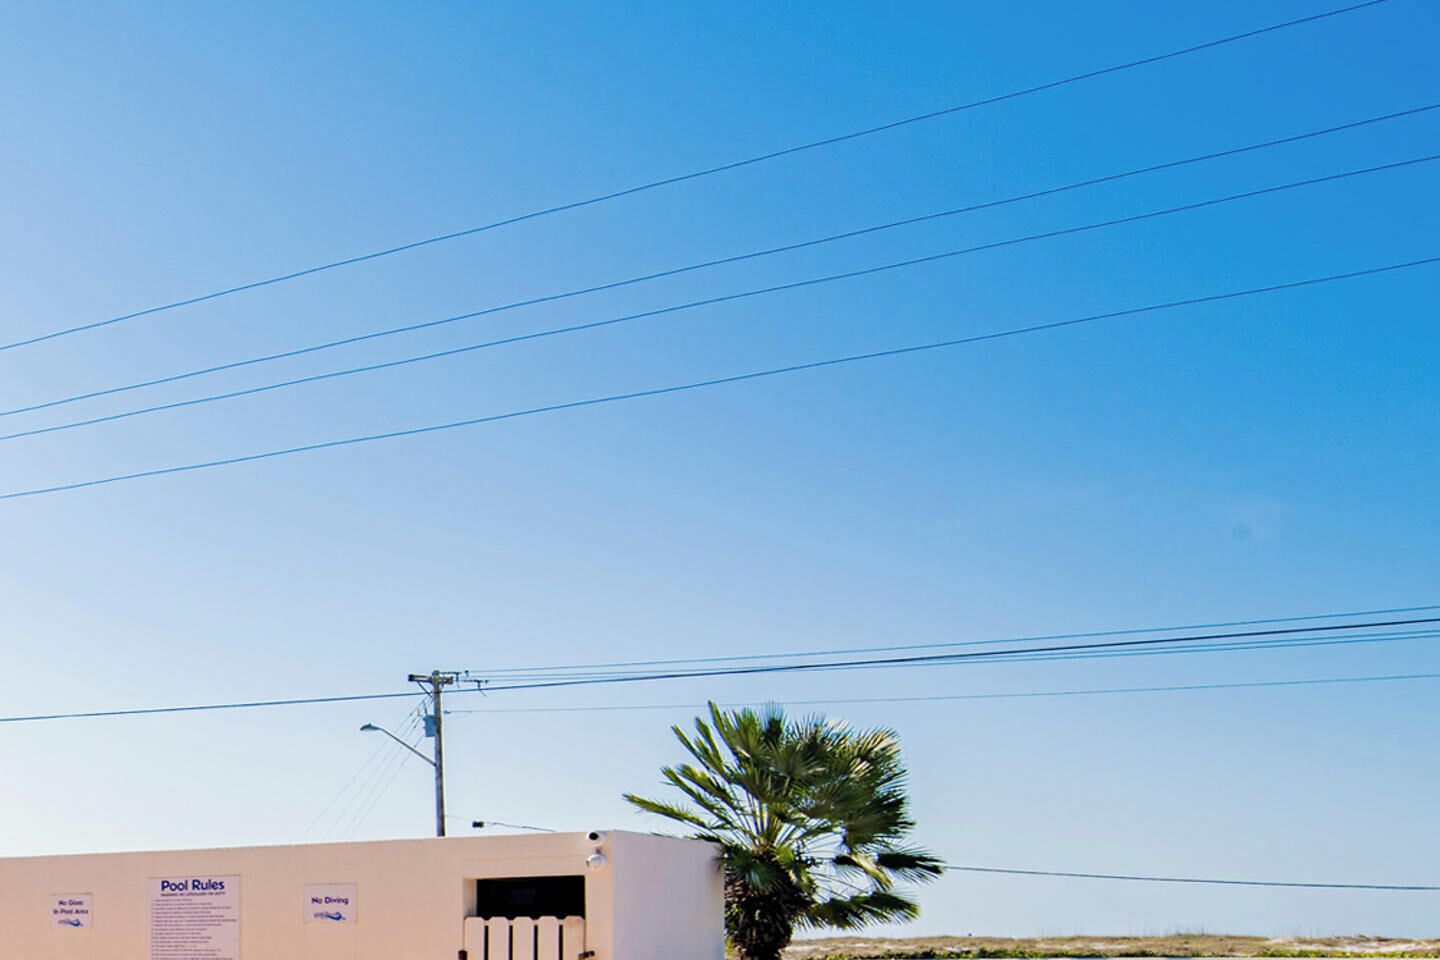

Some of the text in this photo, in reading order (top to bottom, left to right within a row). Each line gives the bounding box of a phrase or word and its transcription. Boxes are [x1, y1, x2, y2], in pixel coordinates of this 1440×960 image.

[160, 879, 225, 892] Pool Rules
[324, 896, 349, 905] Diving
